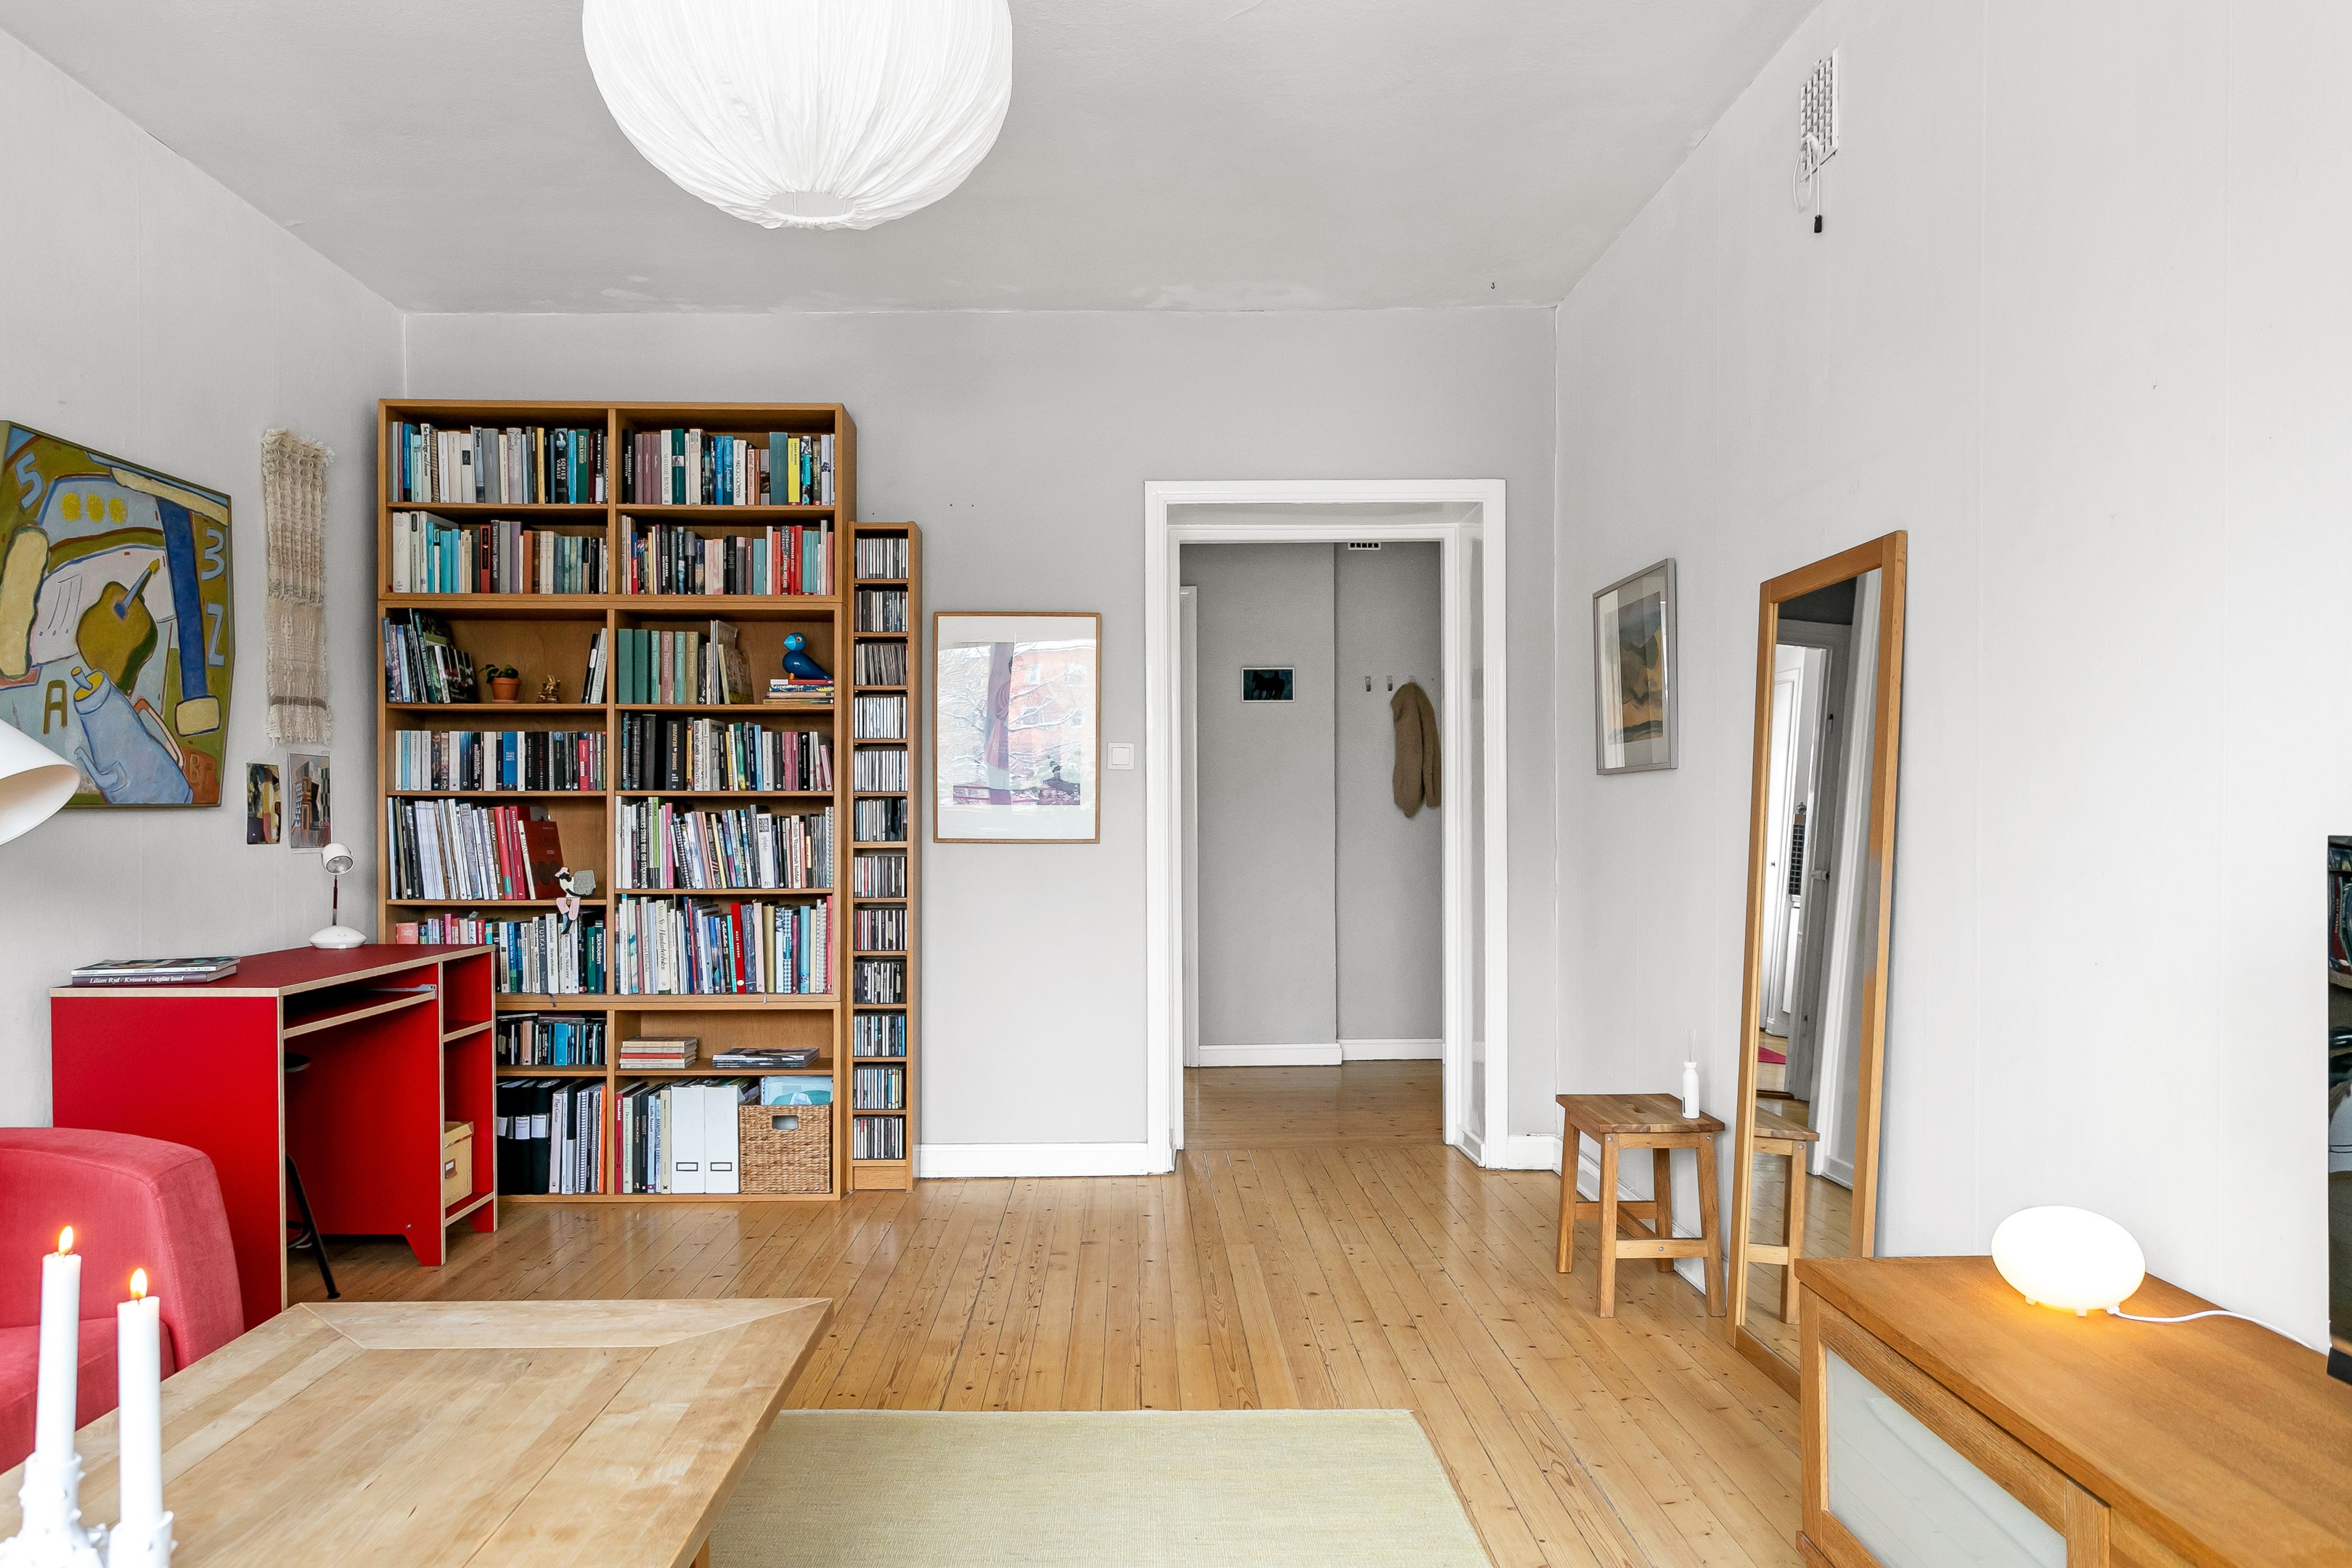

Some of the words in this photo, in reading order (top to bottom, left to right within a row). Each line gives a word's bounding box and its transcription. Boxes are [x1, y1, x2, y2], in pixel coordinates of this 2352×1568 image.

[15, 452, 44, 509] 5
[200, 527, 225, 581] 3
[43, 679, 68, 735] A
